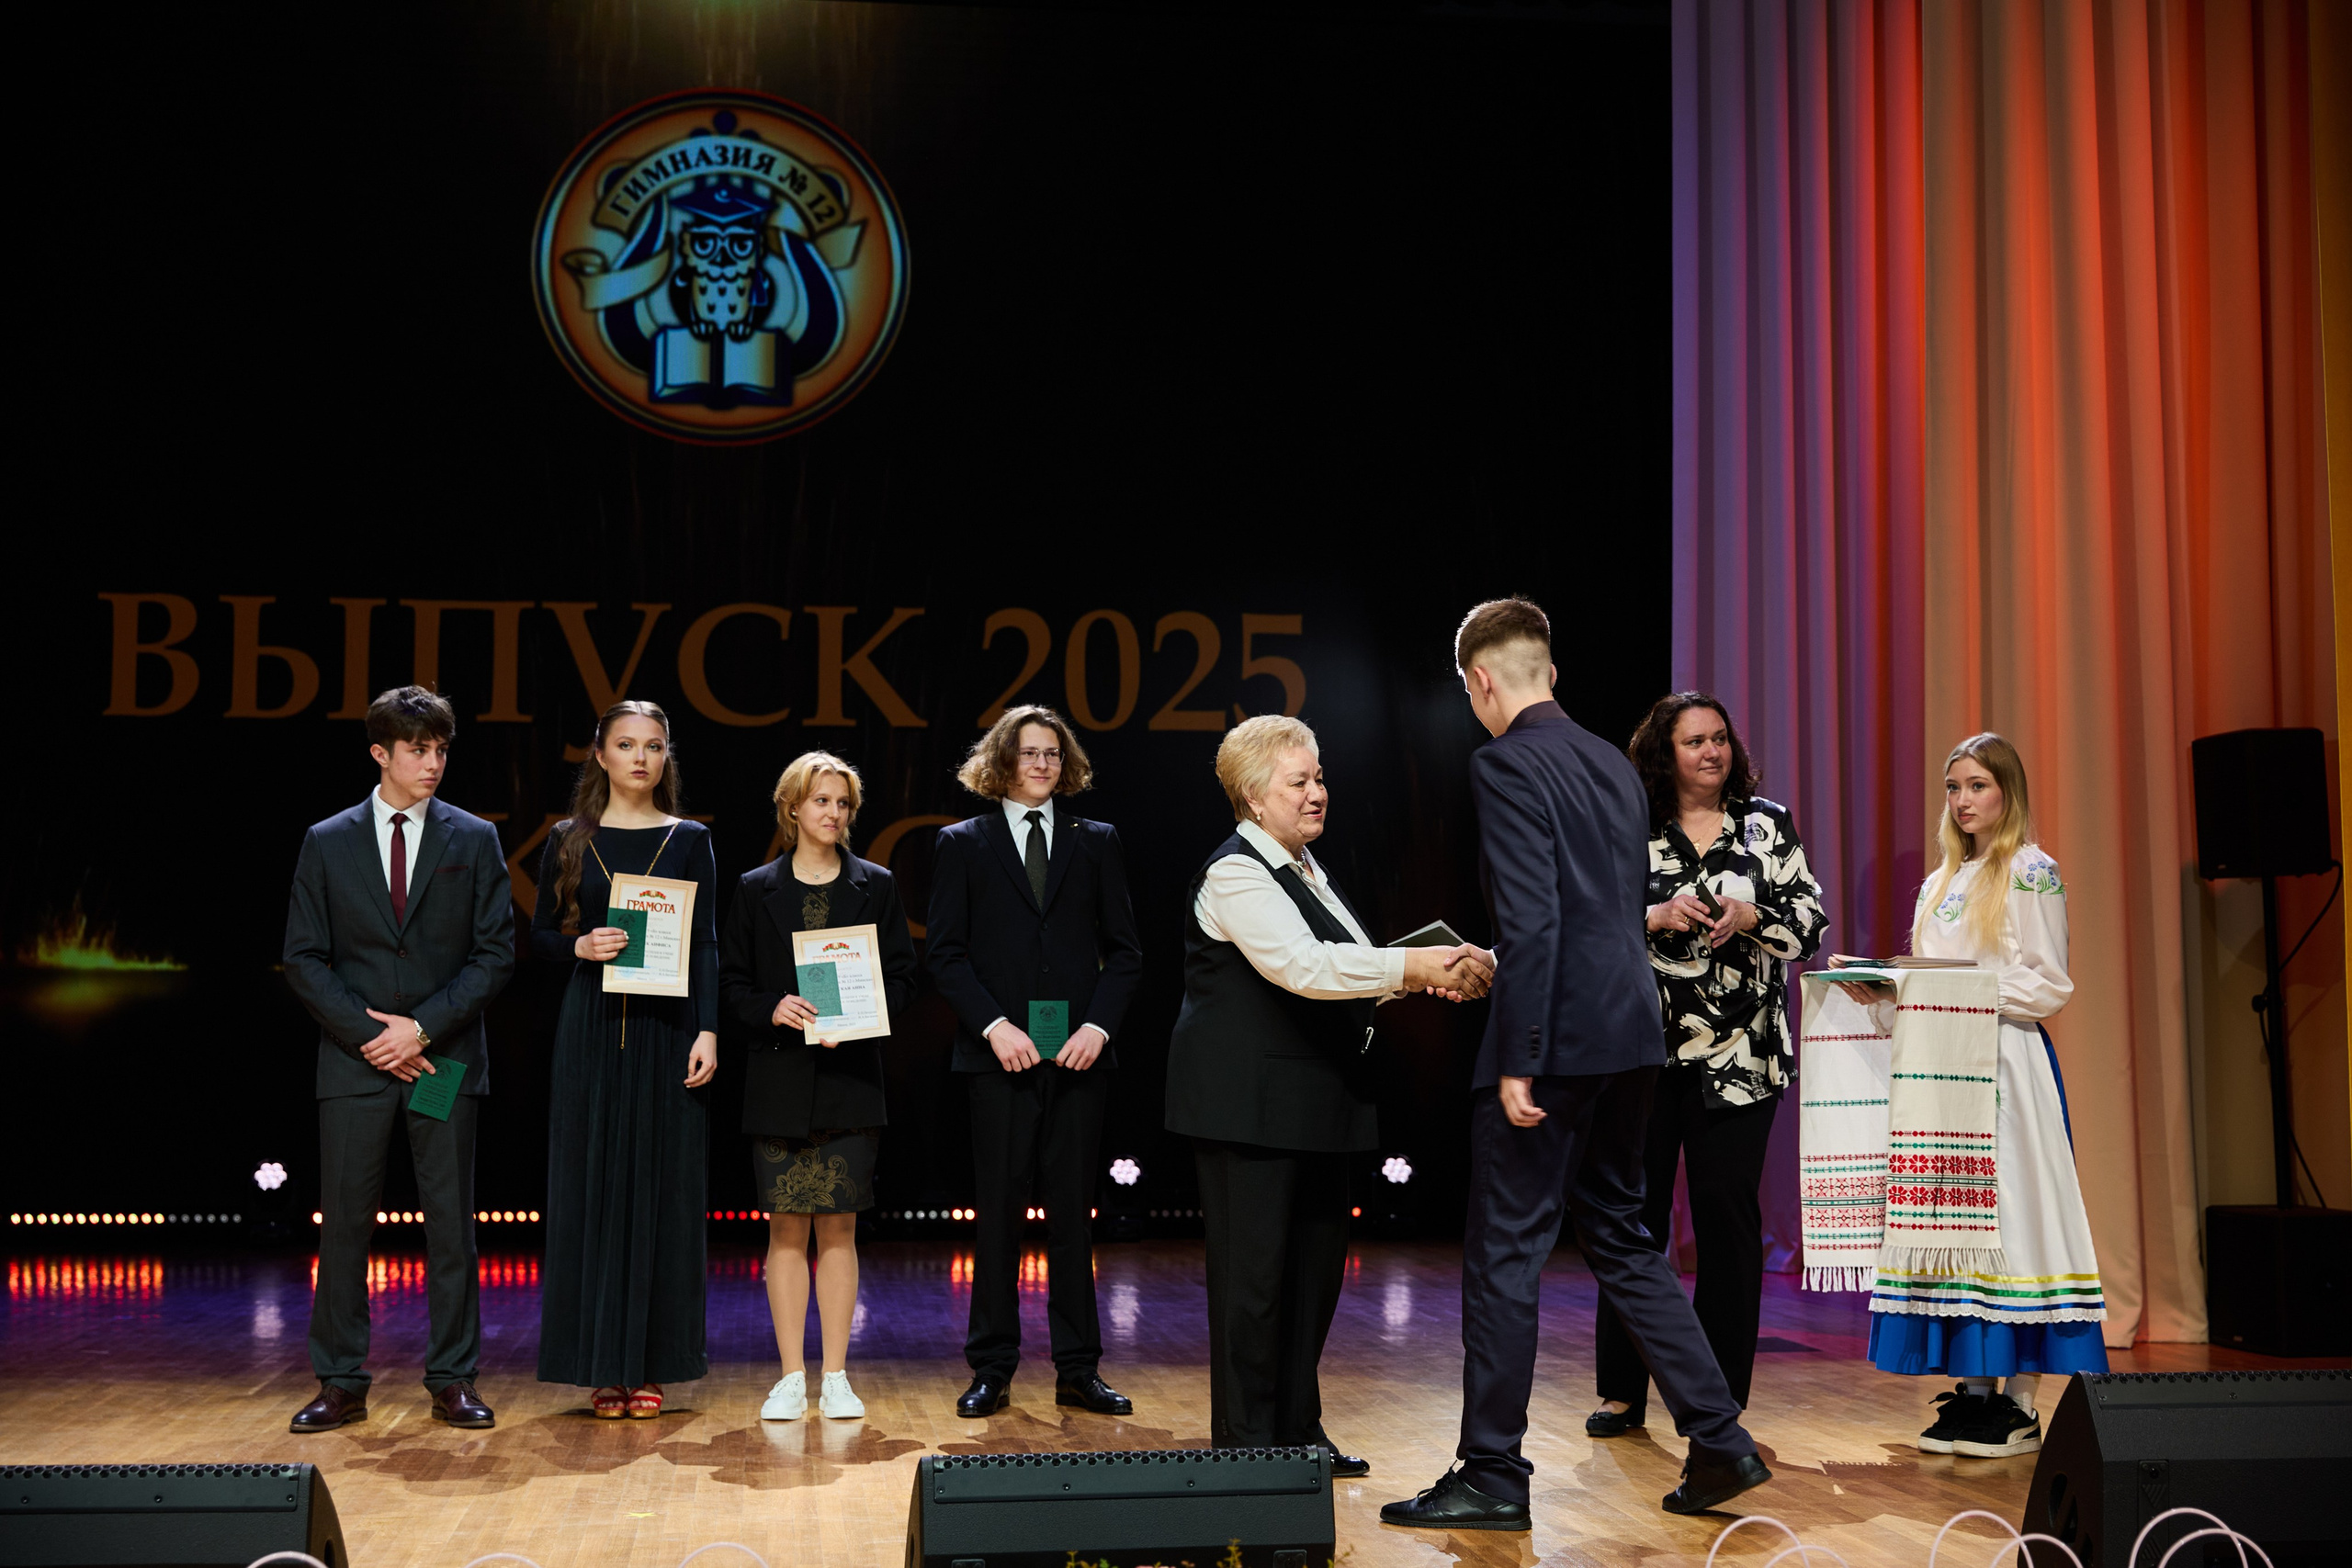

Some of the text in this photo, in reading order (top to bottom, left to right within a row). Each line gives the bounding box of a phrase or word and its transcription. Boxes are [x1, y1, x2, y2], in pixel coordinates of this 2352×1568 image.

[609, 144, 837, 223] ГИМНАЗИЯ № 12
[97, 592, 1307, 762] ВЫПУСК 2025
[627, 899, 675, 914] ГРАМОТА
[811, 952, 862, 964] ГРАМОТА
